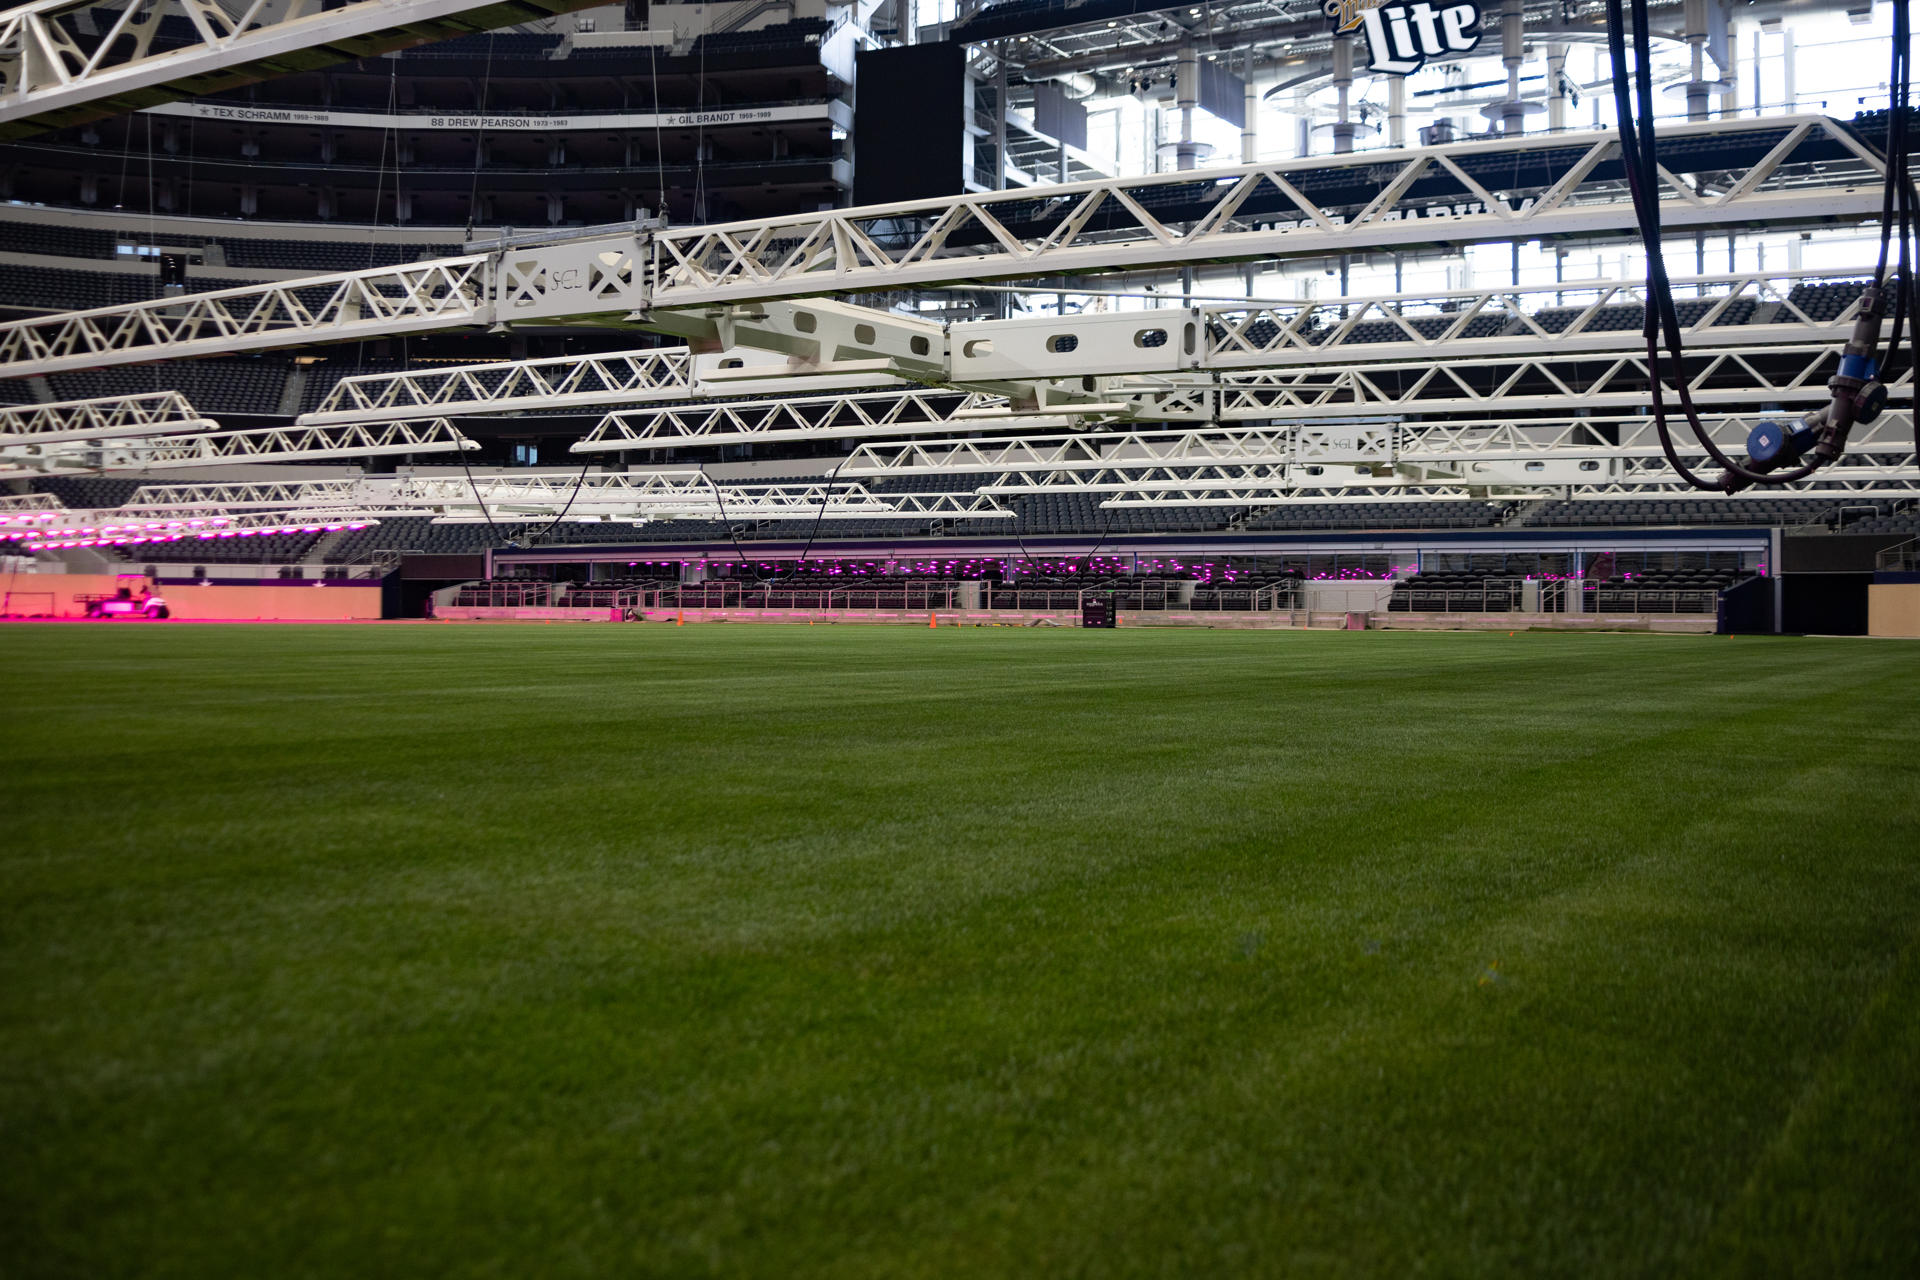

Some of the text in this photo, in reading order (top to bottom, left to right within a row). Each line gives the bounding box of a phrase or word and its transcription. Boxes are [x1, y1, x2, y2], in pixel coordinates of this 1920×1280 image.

[1364, 2, 1478, 73] Lite
[213, 107, 233, 117] TEX
[238, 110, 291, 121] SCHRAMM
[678, 115, 694, 125] GIL
[696, 113, 735, 123] BRANDT
[431, 118, 444, 127] 88
[448, 118, 478, 127] DREW
[481, 119, 530, 128] PEARSON
